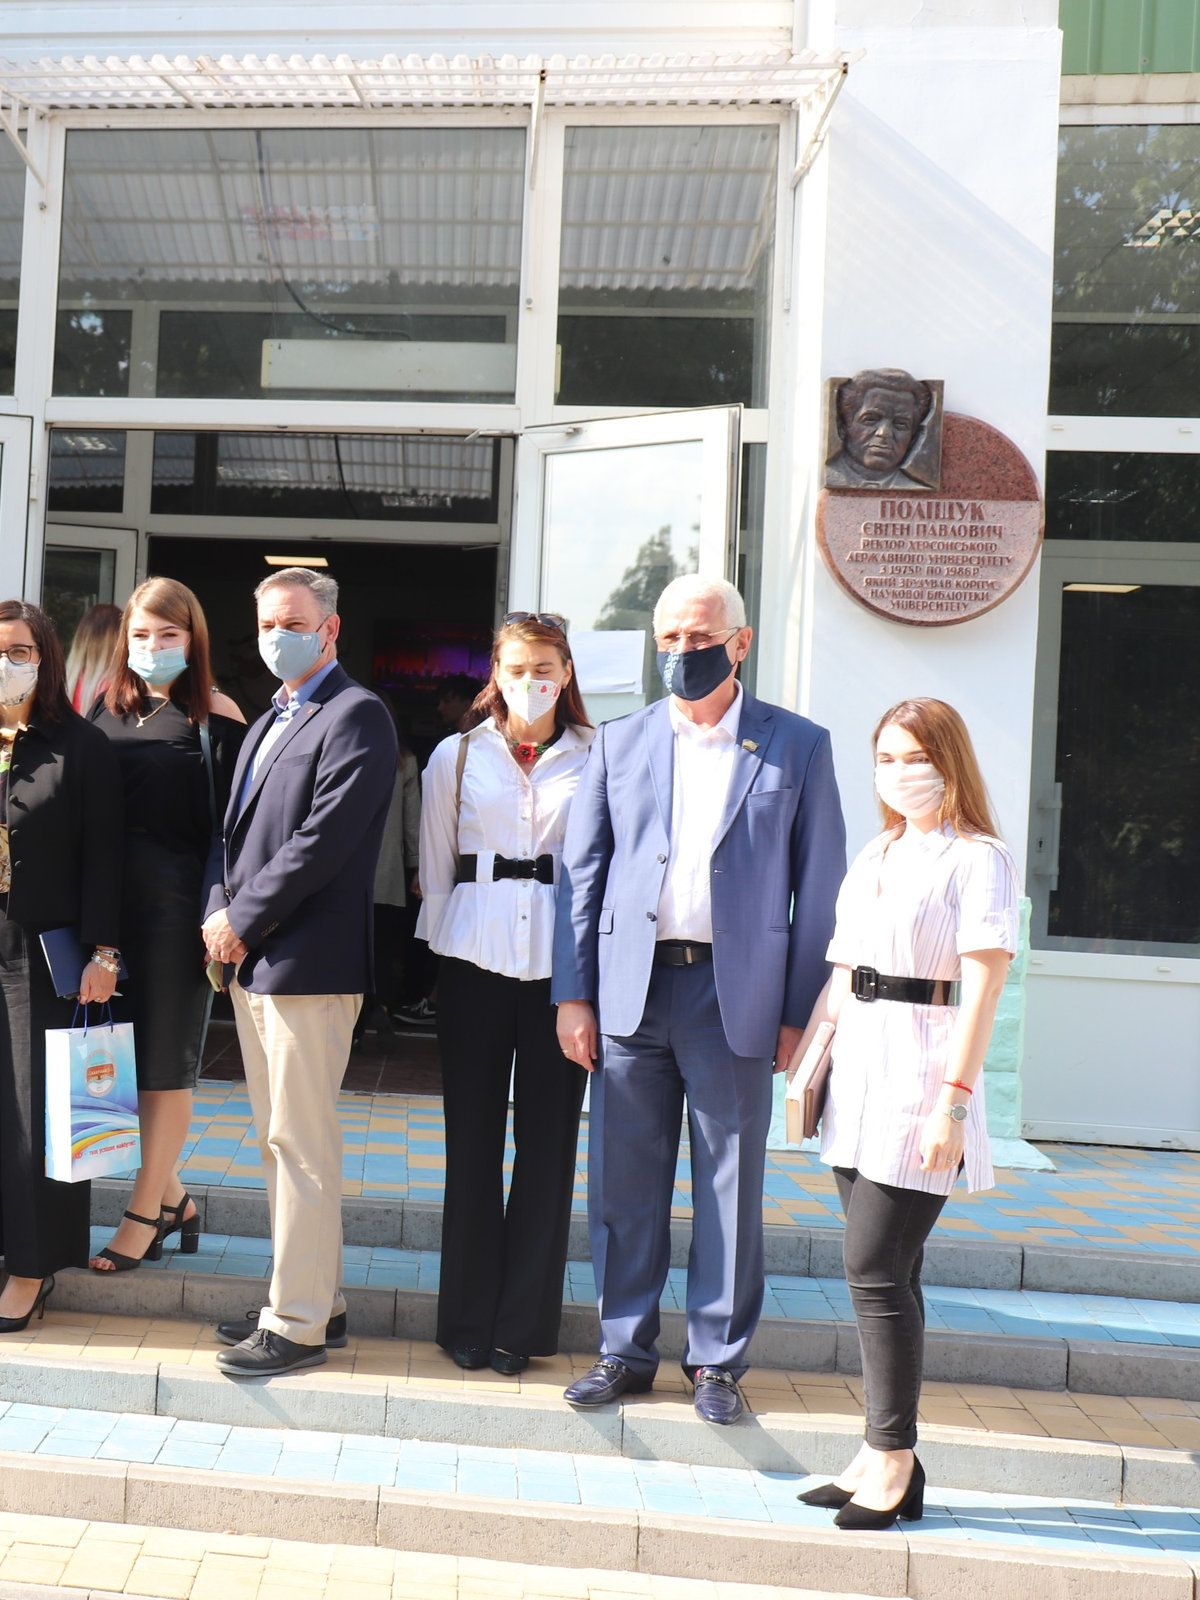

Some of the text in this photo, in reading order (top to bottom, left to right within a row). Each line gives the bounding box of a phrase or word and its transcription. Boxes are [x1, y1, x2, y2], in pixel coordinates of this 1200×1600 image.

[880, 500, 985, 521] ПОЛІЩУК
[862, 521, 1003, 539] ЄВГЕН ПАВЛОВИЧ
[862, 539, 999, 553] РЕКТОР ХЕРСОНСЬКОГО
[846, 552, 1014, 567] ДЕРЖАВНОГО УНІВЕРСИТЕТУ
[891, 600, 969, 612] УНІВЕРСИТЕТУ
